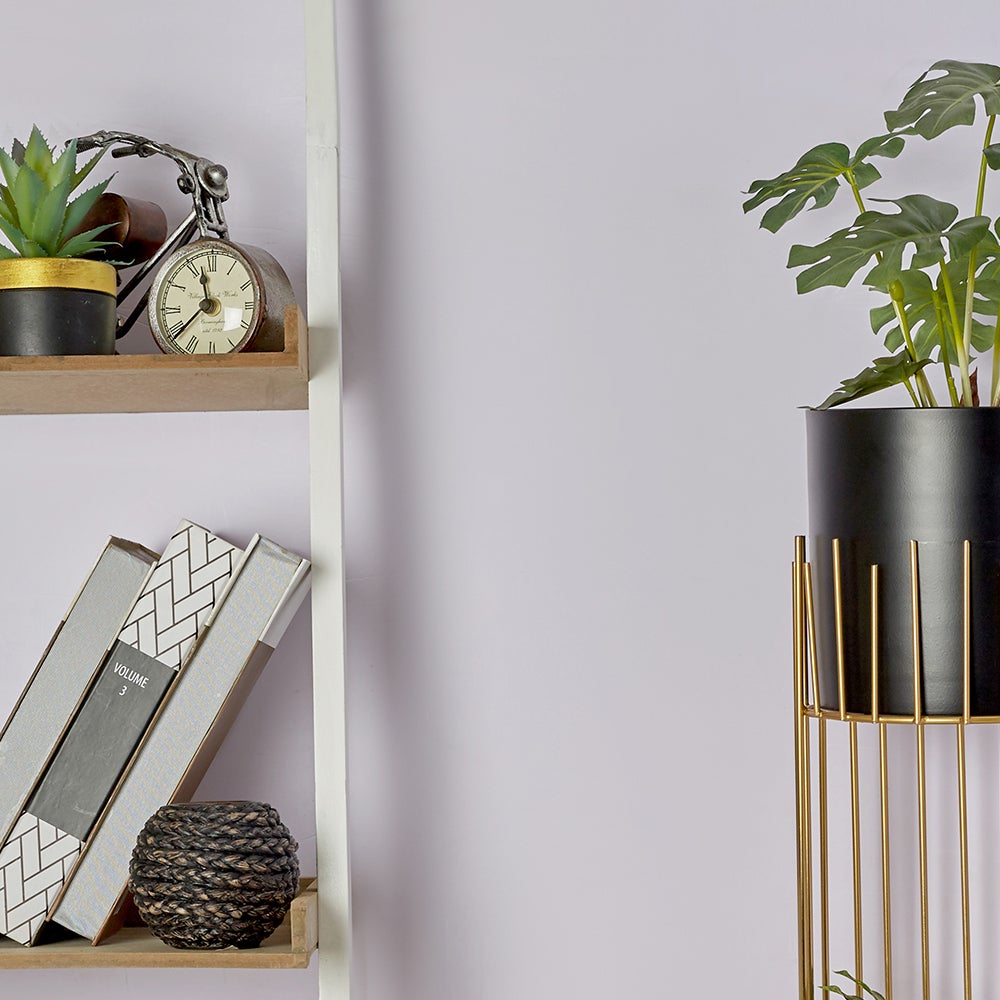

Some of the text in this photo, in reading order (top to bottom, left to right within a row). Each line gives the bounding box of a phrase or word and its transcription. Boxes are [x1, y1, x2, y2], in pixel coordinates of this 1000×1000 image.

[207, 256, 217, 272] XII
[113, 662, 149, 688] VOLUME
[118, 685, 128, 696] 3
